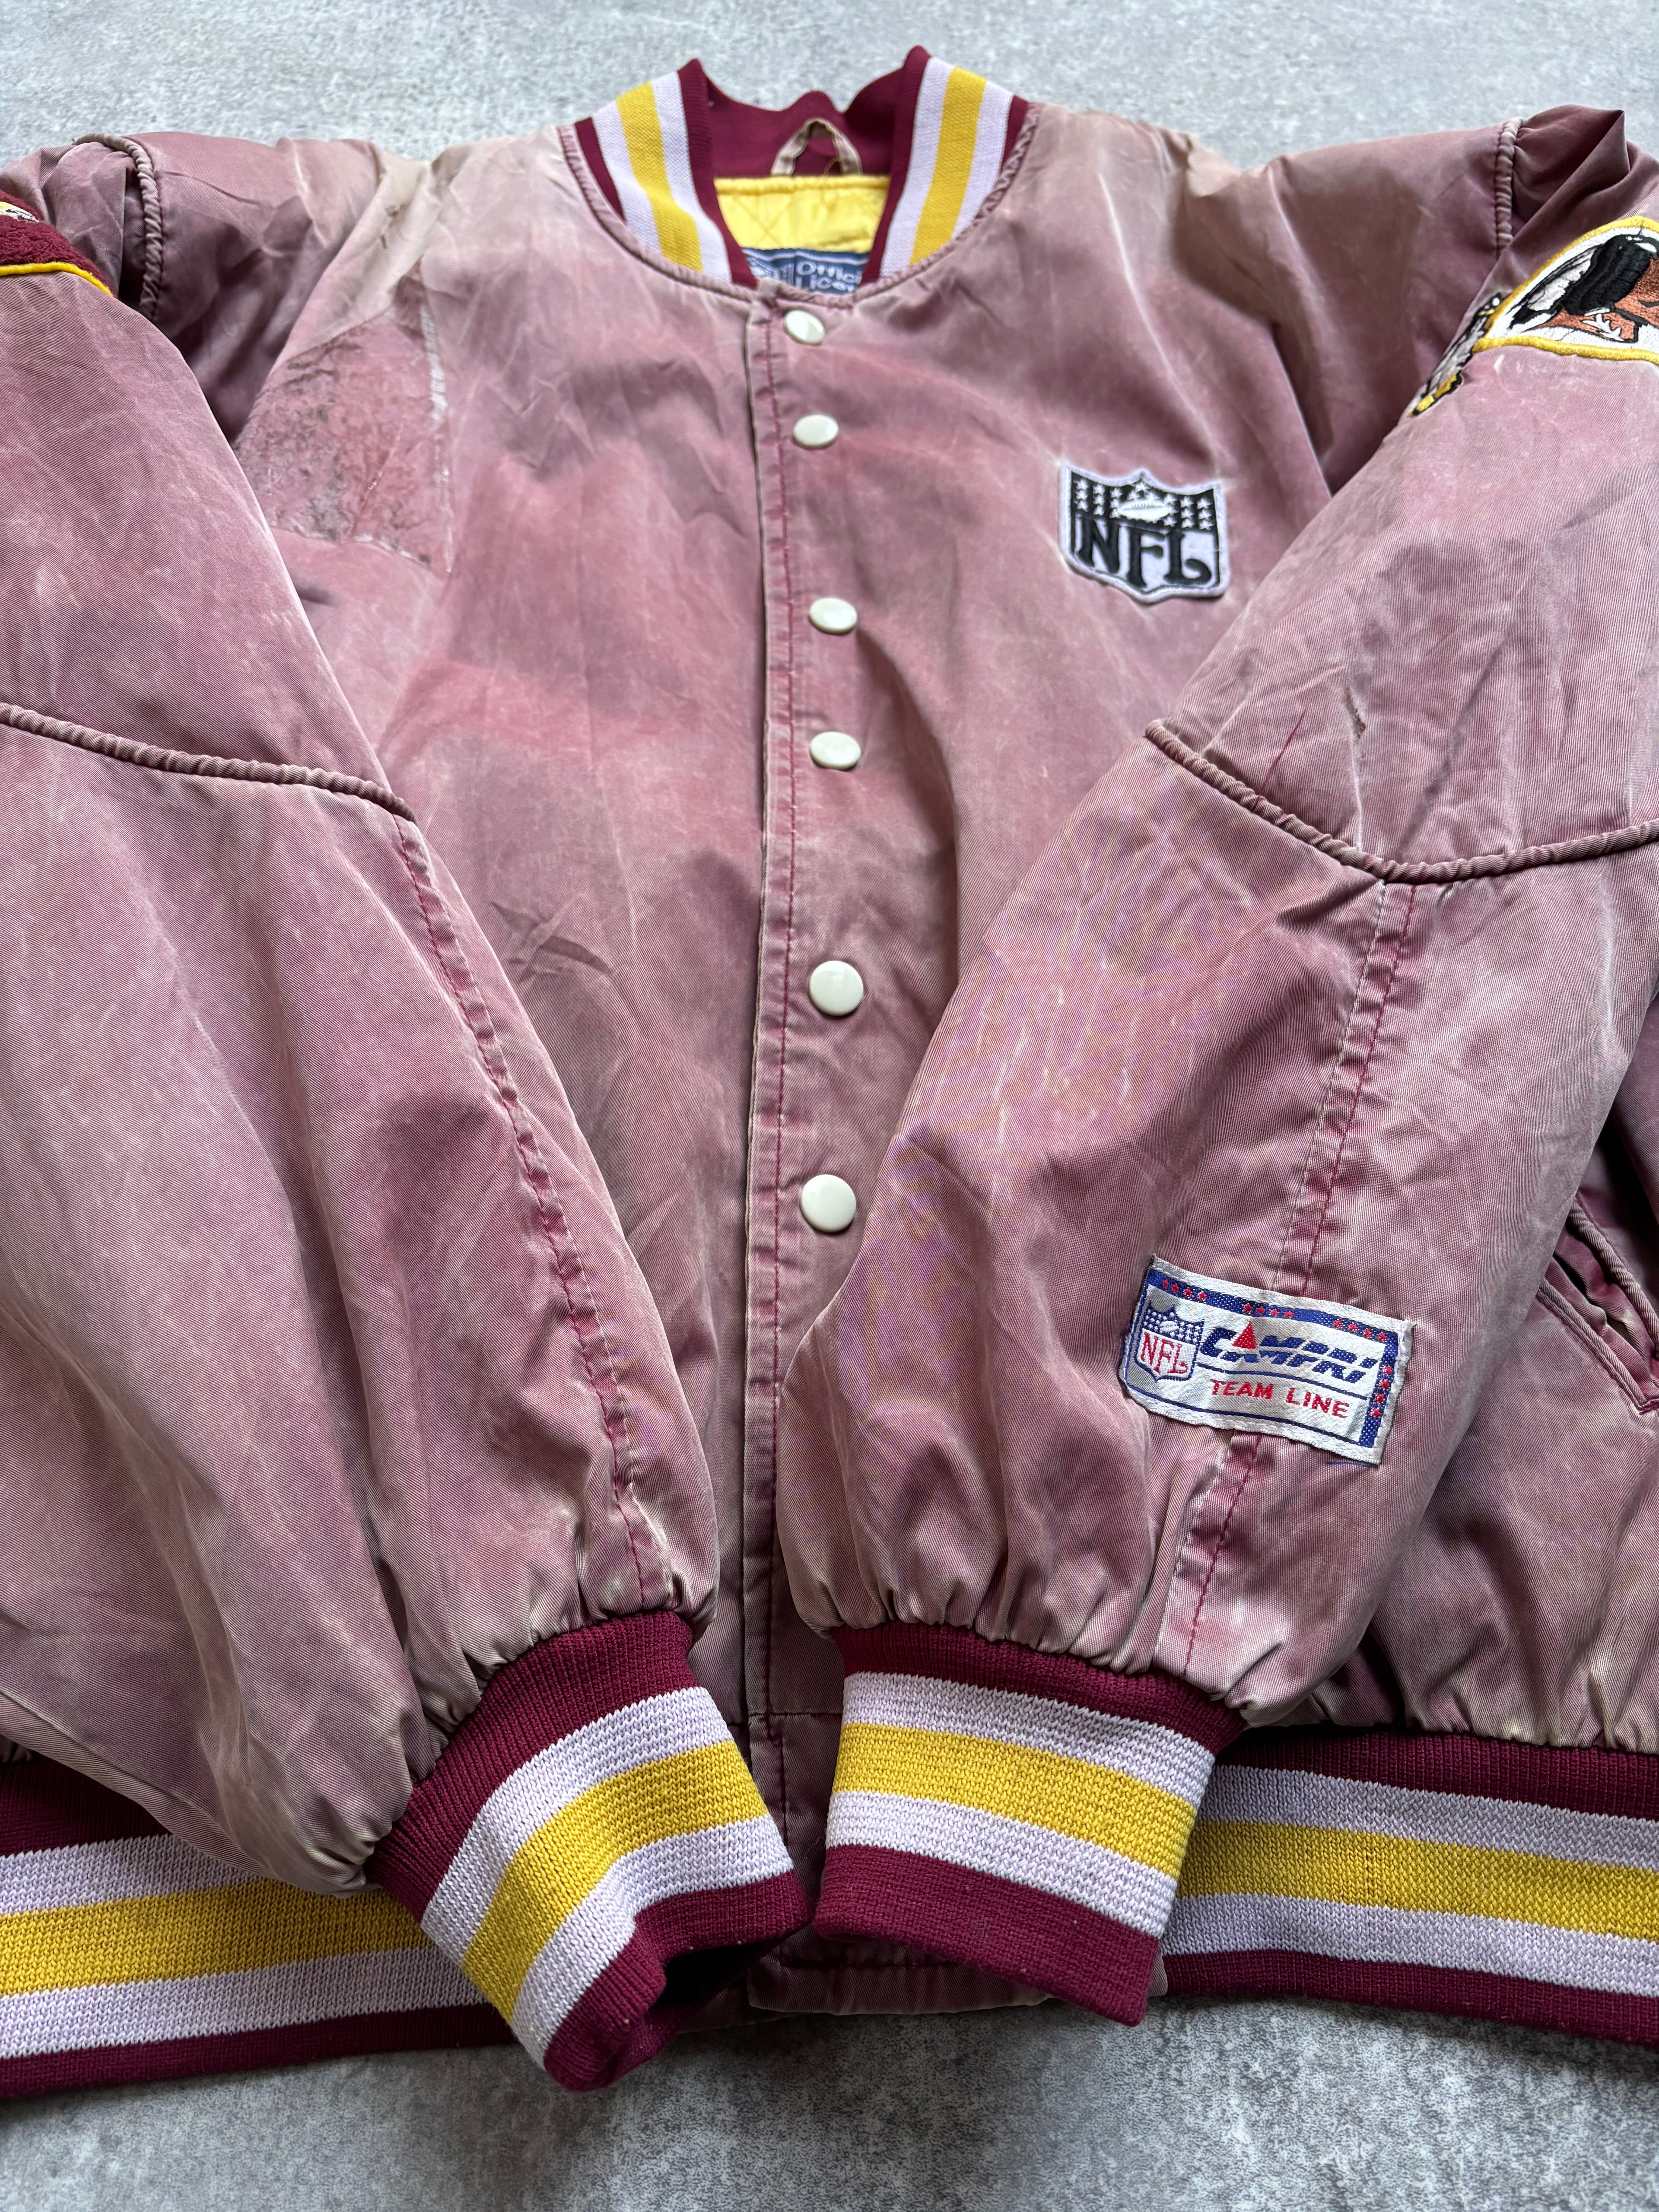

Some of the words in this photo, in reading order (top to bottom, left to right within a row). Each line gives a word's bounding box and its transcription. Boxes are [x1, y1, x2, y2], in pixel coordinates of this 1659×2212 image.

[1078, 516, 1212, 588] NFL
[1141, 1332, 1188, 1376] NFL
[1199, 1321, 1377, 1383] CAMPRI
[1210, 1379, 1274, 1400] TEAM
[1286, 1387, 1350, 1419] LINE
